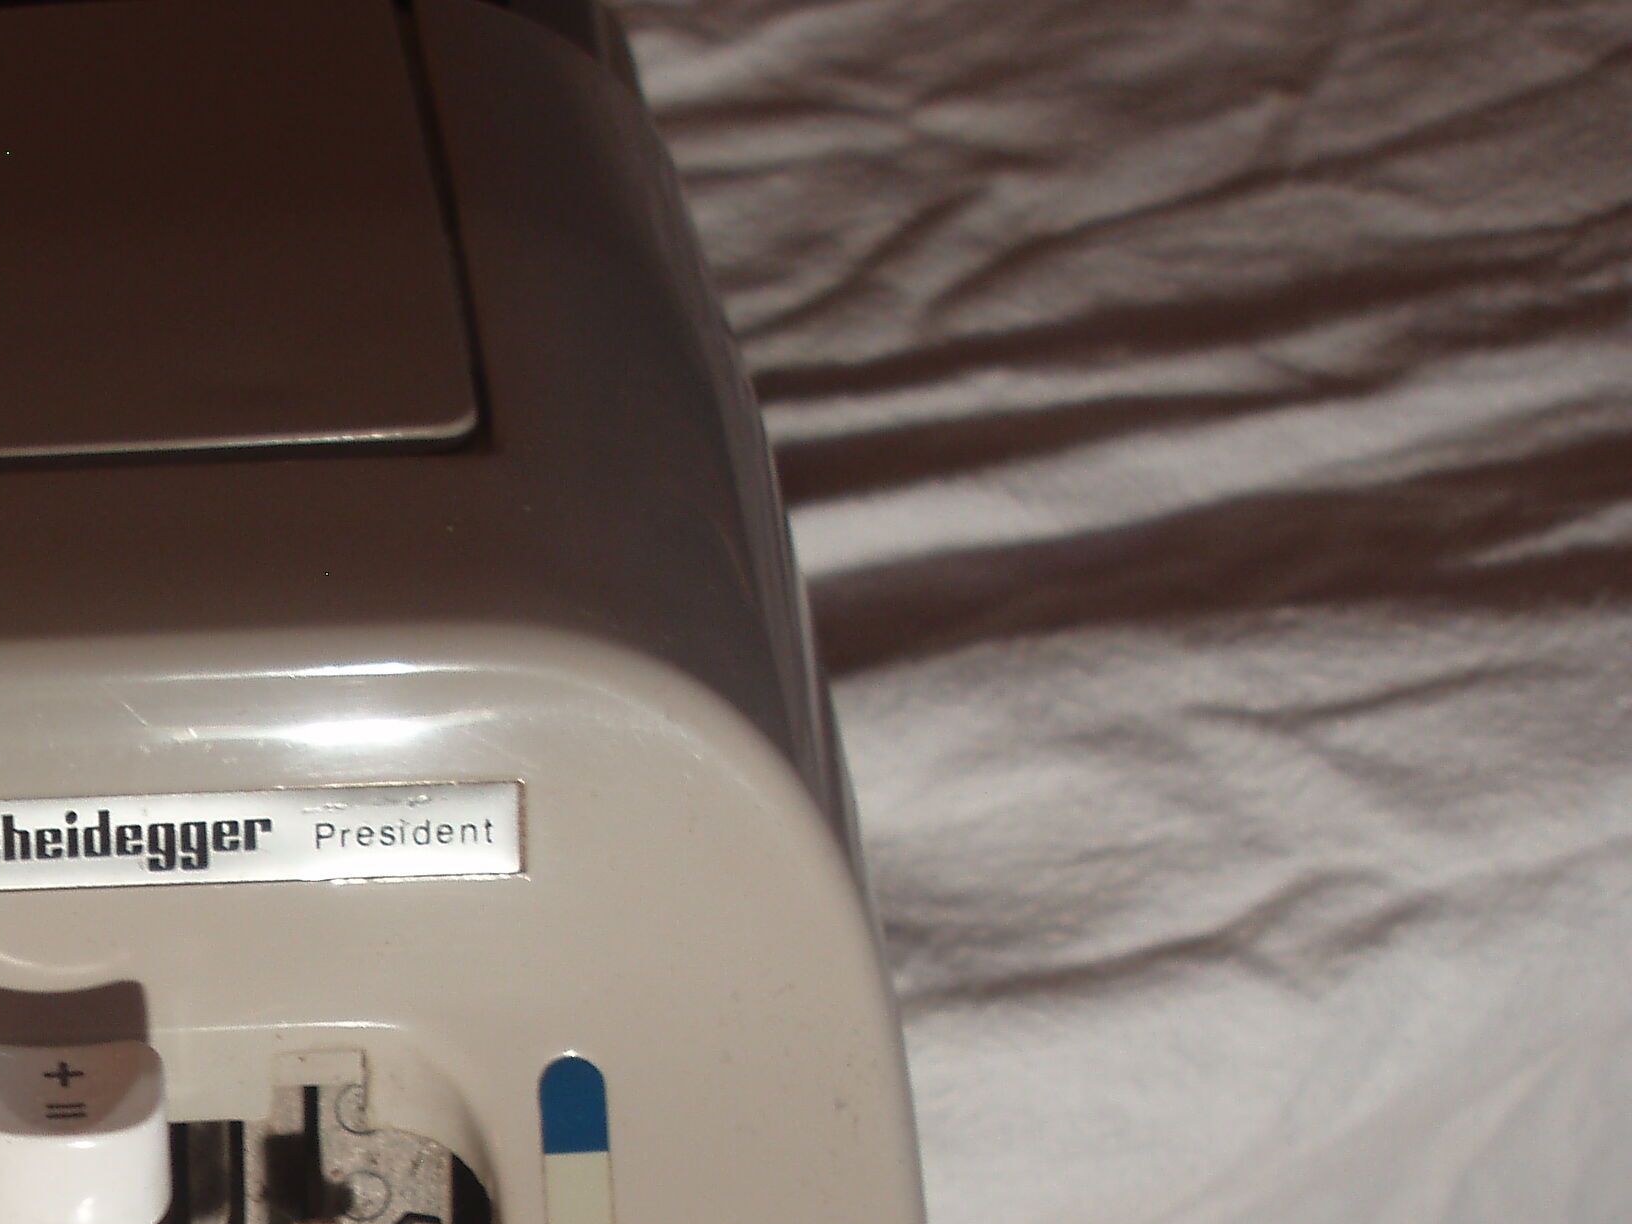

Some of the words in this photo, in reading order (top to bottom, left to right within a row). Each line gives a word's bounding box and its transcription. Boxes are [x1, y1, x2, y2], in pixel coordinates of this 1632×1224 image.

[314, 818, 496, 850] President
[45, 1062, 84, 1088] +
[46, 1102, 87, 1119] =
